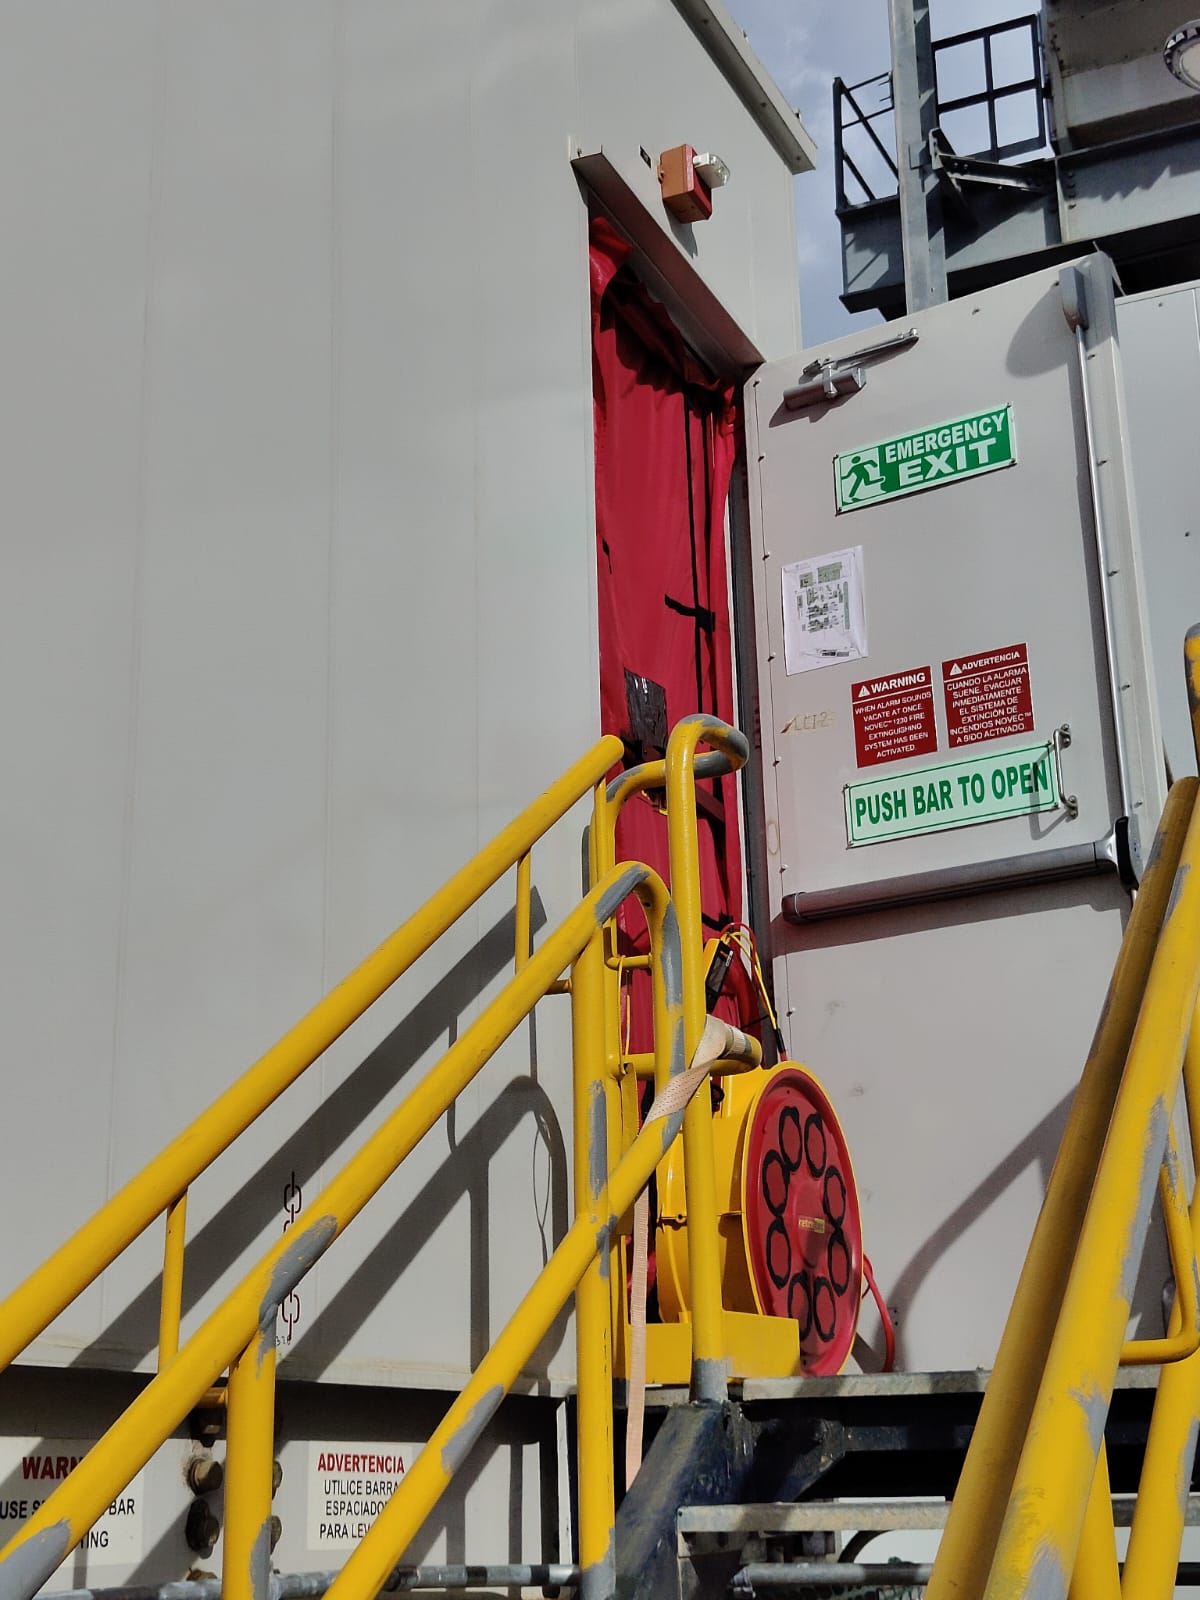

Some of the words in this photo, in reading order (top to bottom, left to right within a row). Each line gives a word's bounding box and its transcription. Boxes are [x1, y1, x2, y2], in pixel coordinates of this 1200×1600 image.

[885, 412, 1006, 464] EMERGENCY
[898, 437, 997, 487] EXIT
[962, 651, 1020, 670] ADVERTENCIA
[870, 672, 926, 694] WARNING
[947, 678, 981, 691] CUANDO
[982, 674, 992, 683] LA
[994, 666, 1027, 679] ALARMA
[984, 677, 1022, 692] EVACUAR
[855, 704, 876, 715] WHEN
[877, 699, 901, 710] ALARM
[902, 691, 932, 704] SOUNDS
[960, 708, 969, 716] EL
[970, 699, 1006, 713] SISTEMA
[1007, 696, 1018, 705] DE
[863, 711, 890, 722] VACATE
[892, 708, 900, 716] AT
[909, 712, 926, 721] FIRE
[961, 708, 1005, 724] EXTINCIÓN
[1006, 705, 1017, 714] DE
[868, 723, 922, 741] EXTINGUISHING
[949, 720, 993, 735] INCENDIOS
[864, 739, 893, 751] SYSTEM
[893, 736, 908, 744] HAS
[909, 732, 928, 741] BEEN
[957, 736, 962, 744] A
[963, 732, 983, 742] SIDO
[855, 788, 908, 828] PUSH
[912, 780, 954, 816] BAR
[957, 773, 986, 806] TO
[991, 759, 1049, 800] OPEN
[22, 1456, 84, 1480] WARN
[317, 1453, 405, 1474] ADVERTENCIA
[324, 1479, 363, 1496] UTILICE
[0, 1500, 28, 1520] USE
[109, 1498, 135, 1516] BAR
[325, 1500, 388, 1516] ESPACIADO
[320, 1523, 349, 1539] PARA
[351, 1523, 371, 1539] LEV
